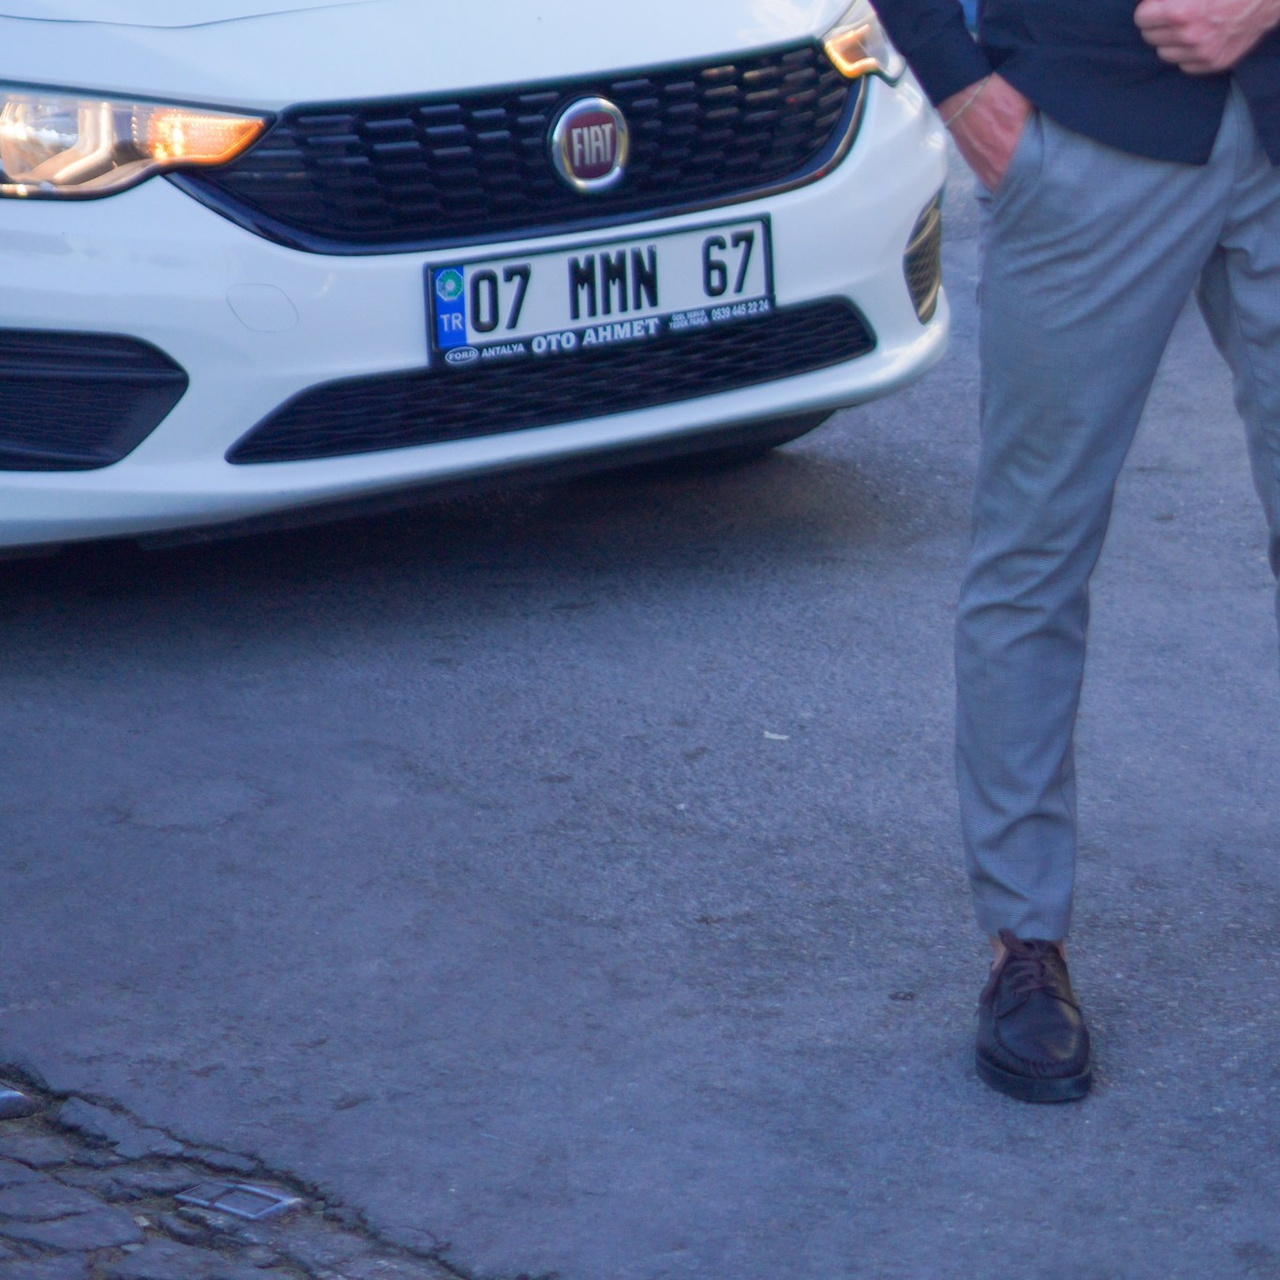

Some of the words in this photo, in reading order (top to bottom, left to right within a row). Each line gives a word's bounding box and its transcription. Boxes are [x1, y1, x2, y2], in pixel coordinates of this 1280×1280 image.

[571, 122, 614, 167] FIAT
[470, 262, 531, 333] 07
[567, 244, 658, 320] MMN
[702, 228, 755, 297] 67
[439, 312, 464, 333] TR
[747, 301, 758, 314] 22
[450, 348, 477, 360] FORD
[481, 342, 525, 358] ANTALYA
[531, 331, 577, 354] OTO
[581, 317, 661, 346] AHMET
